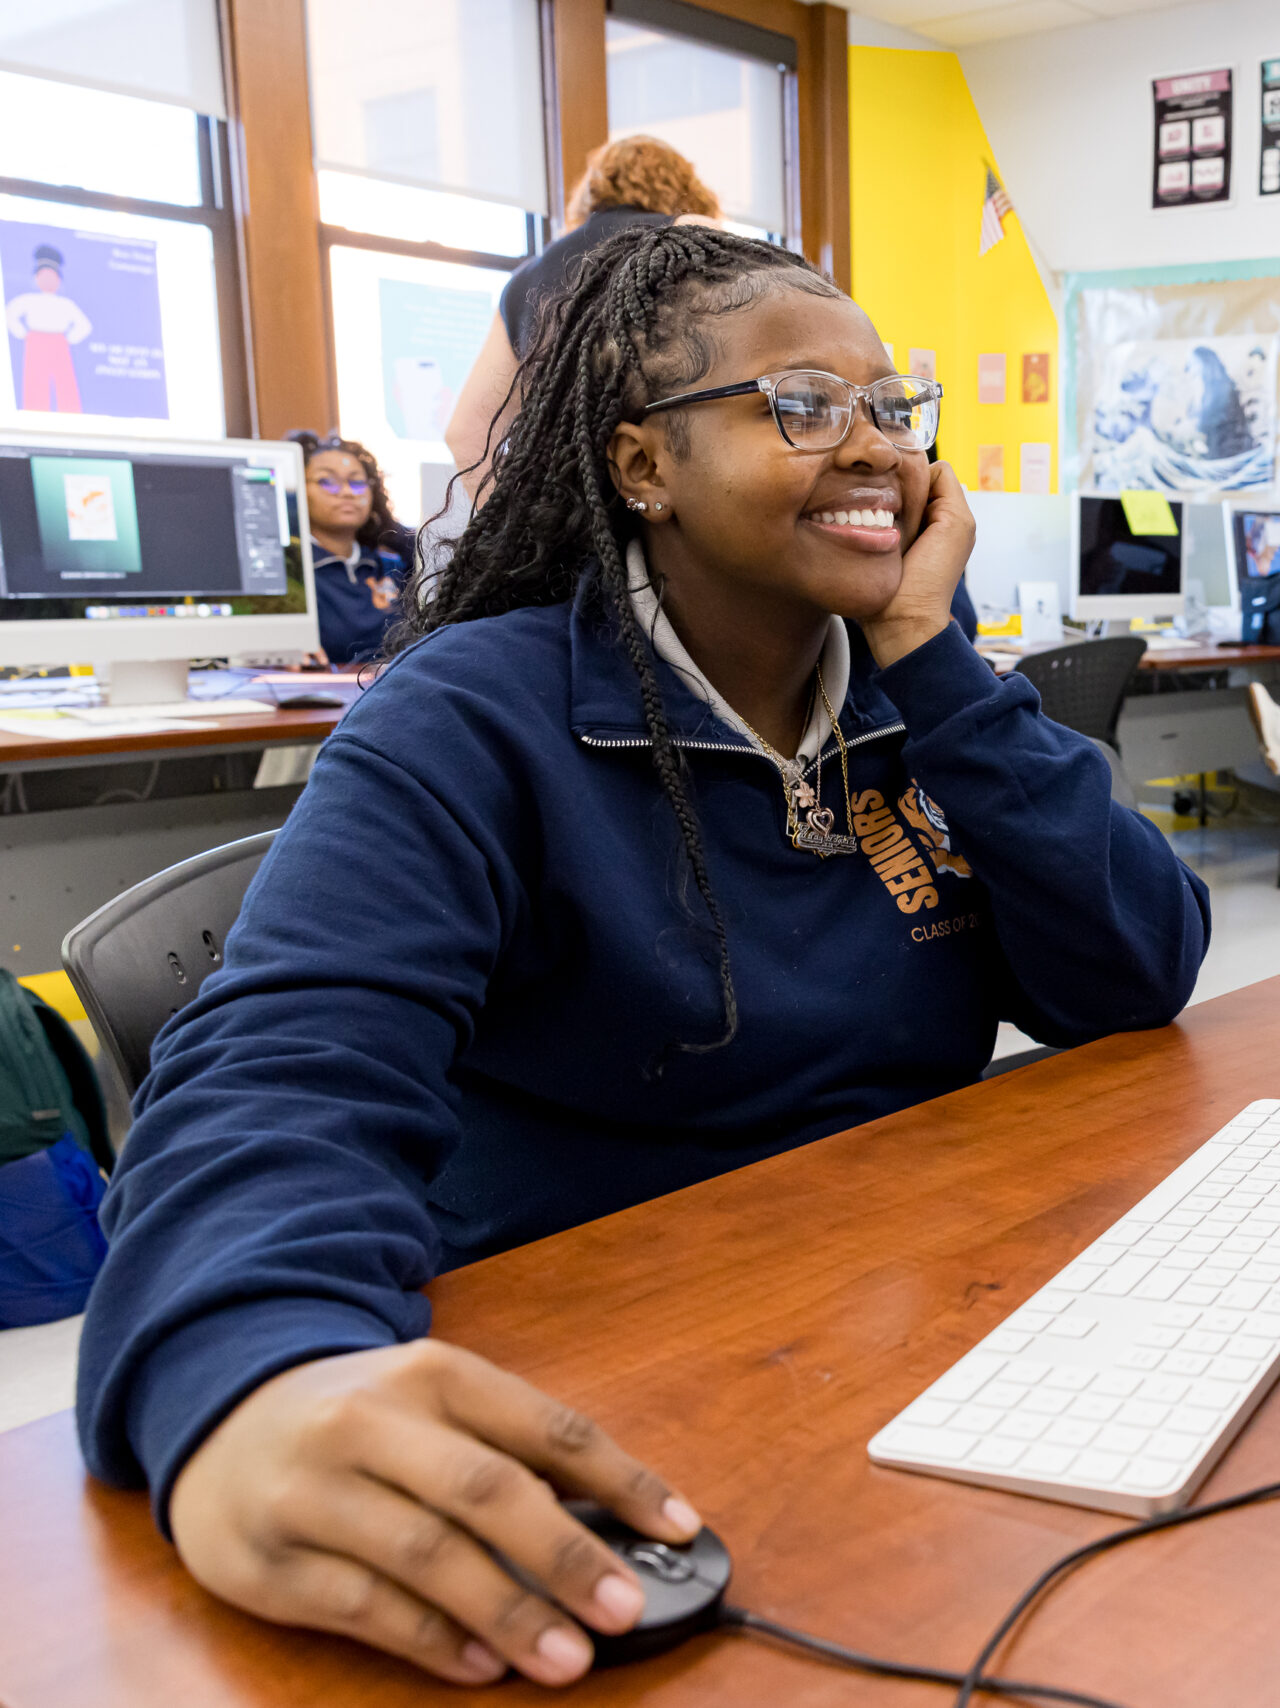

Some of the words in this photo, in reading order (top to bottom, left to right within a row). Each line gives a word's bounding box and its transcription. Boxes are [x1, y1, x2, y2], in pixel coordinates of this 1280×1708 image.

[851, 789, 939, 914] SENIORS
[911, 920, 951, 942] CLASS
[952, 915, 966, 932] OF
